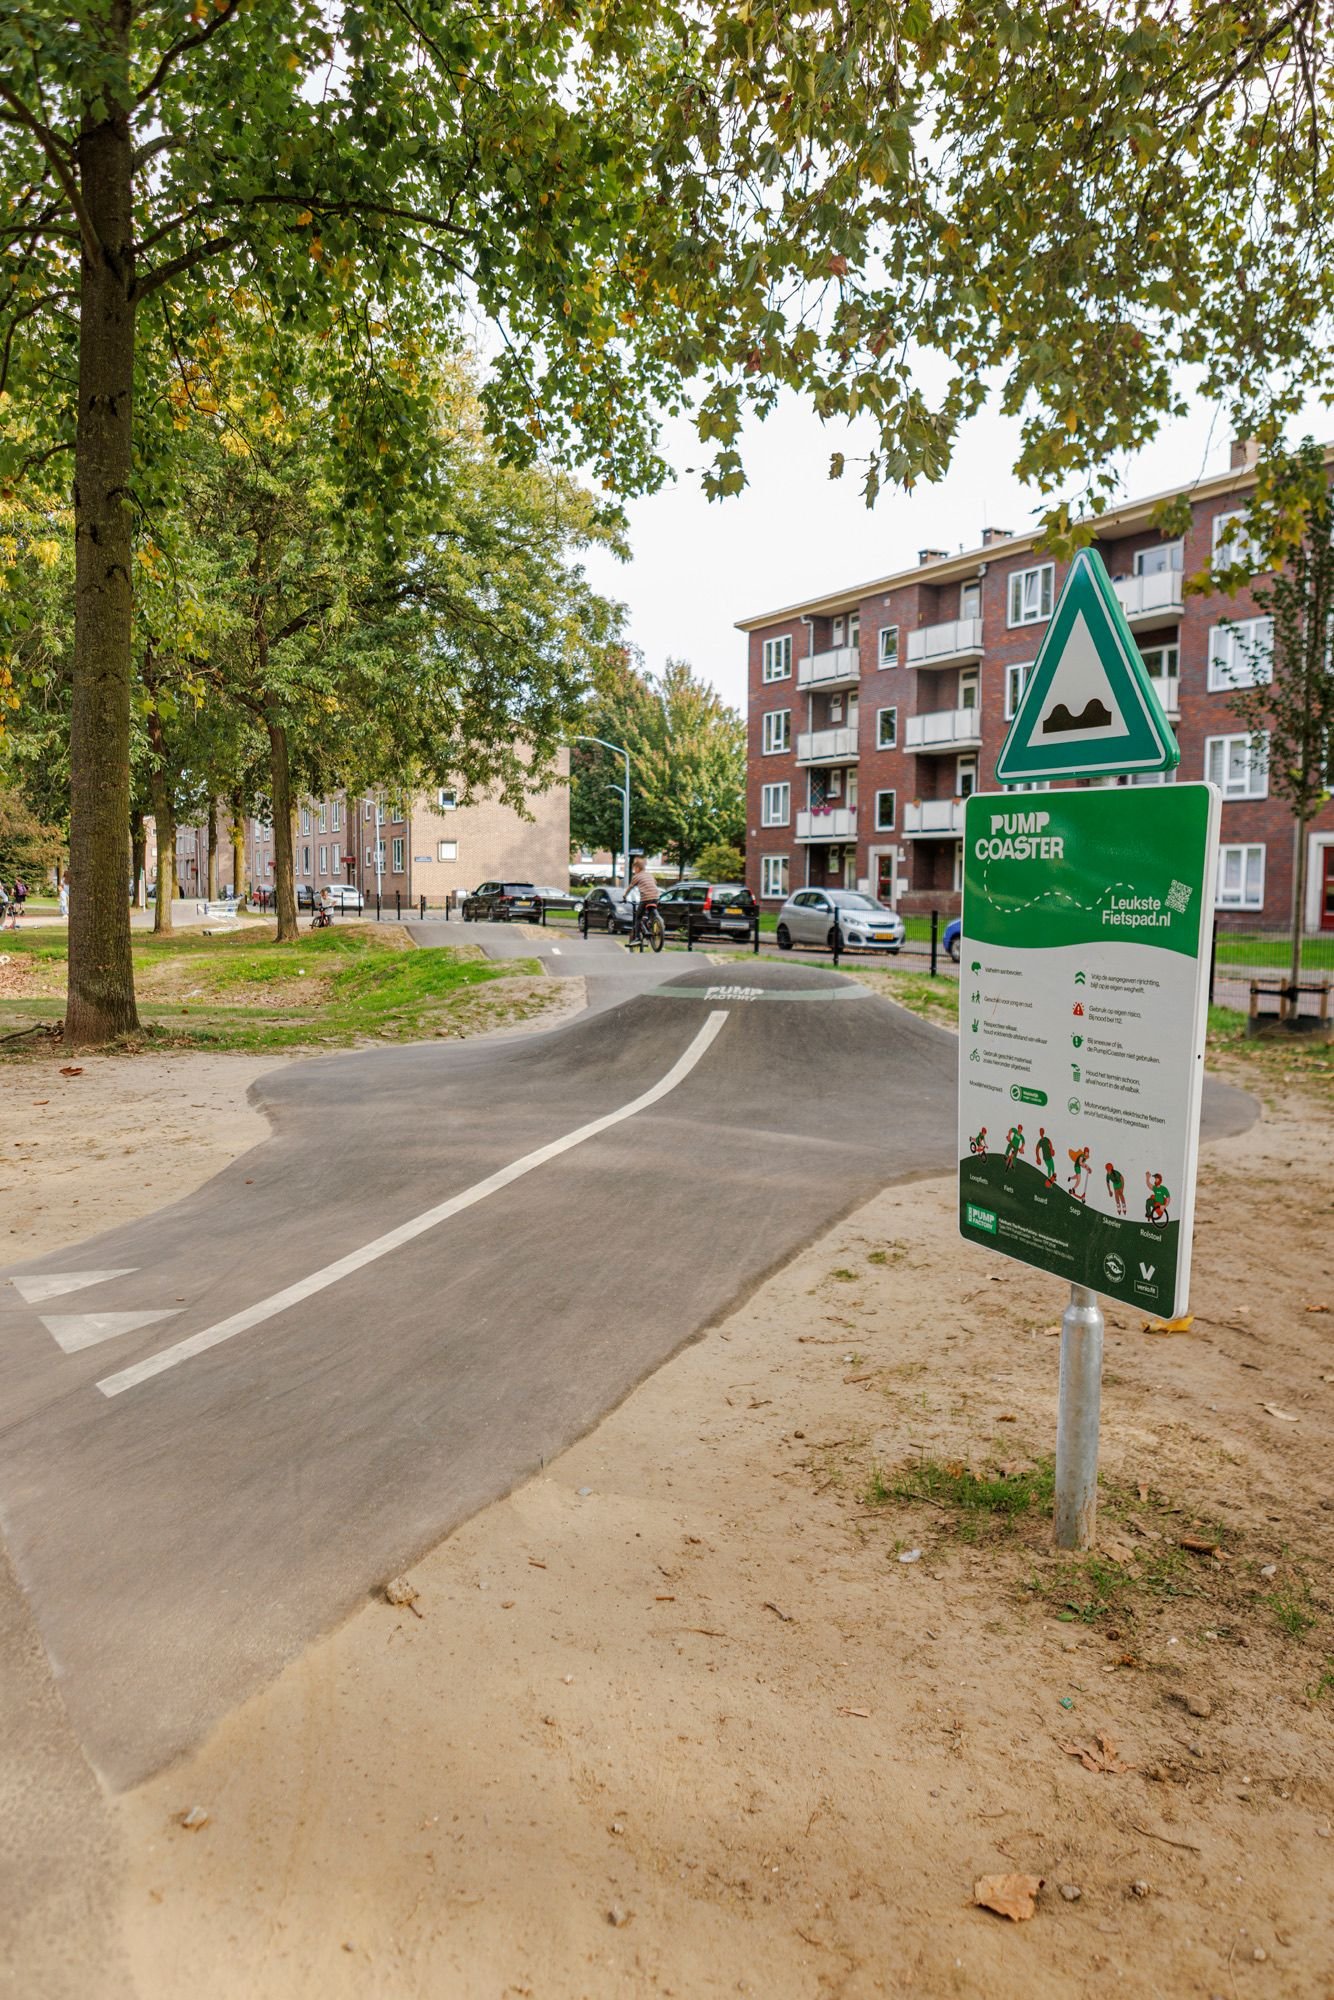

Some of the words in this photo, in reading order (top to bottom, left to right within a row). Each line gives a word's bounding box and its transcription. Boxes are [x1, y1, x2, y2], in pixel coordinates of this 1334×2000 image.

[990, 811, 1050, 835] PUMP
[975, 836, 1064, 860] COASTER
[1111, 895, 1161, 911] Leukste
[1102, 910, 1171, 928] Fietspad.nl
[705, 986, 764, 996] PUMP
[972, 1207, 995, 1223] PUMP
[1139, 1228, 1162, 1242] Rolstoel
